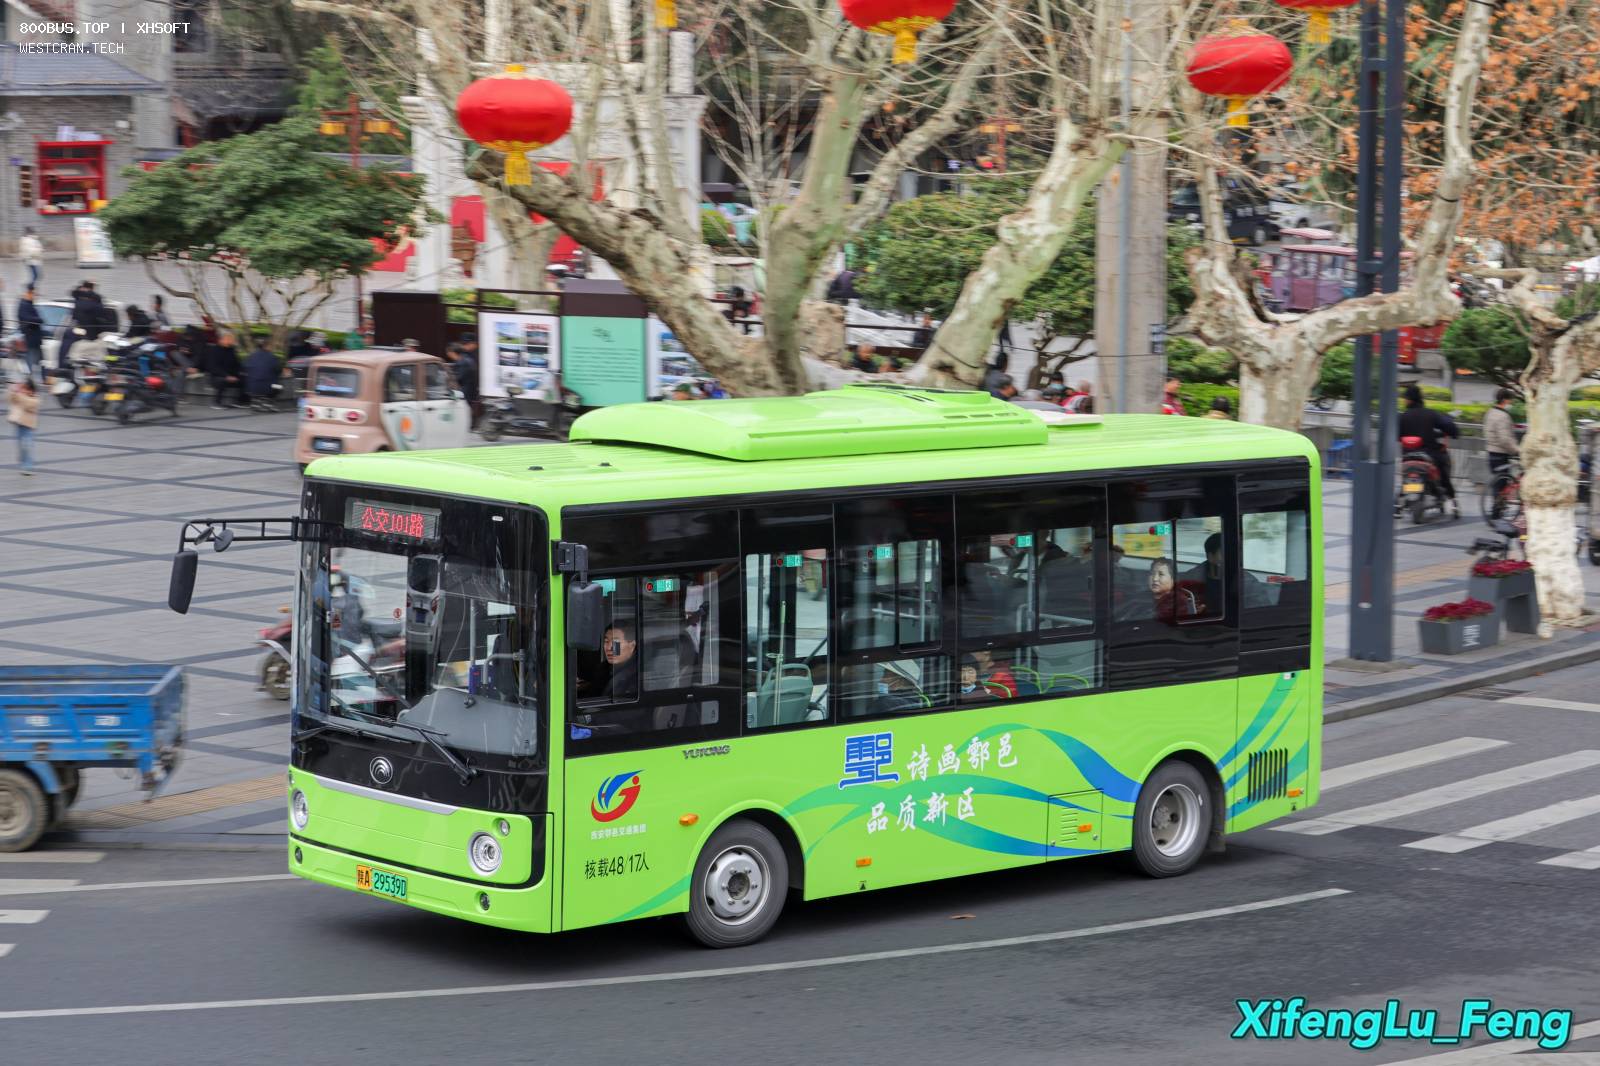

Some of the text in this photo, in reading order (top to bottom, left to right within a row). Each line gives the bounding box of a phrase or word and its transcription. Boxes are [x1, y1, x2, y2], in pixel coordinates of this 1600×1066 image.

[361, 506, 424, 538] 公交101路
[681, 744, 731, 760] YUTONG
[866, 786, 976, 834] 品质新区
